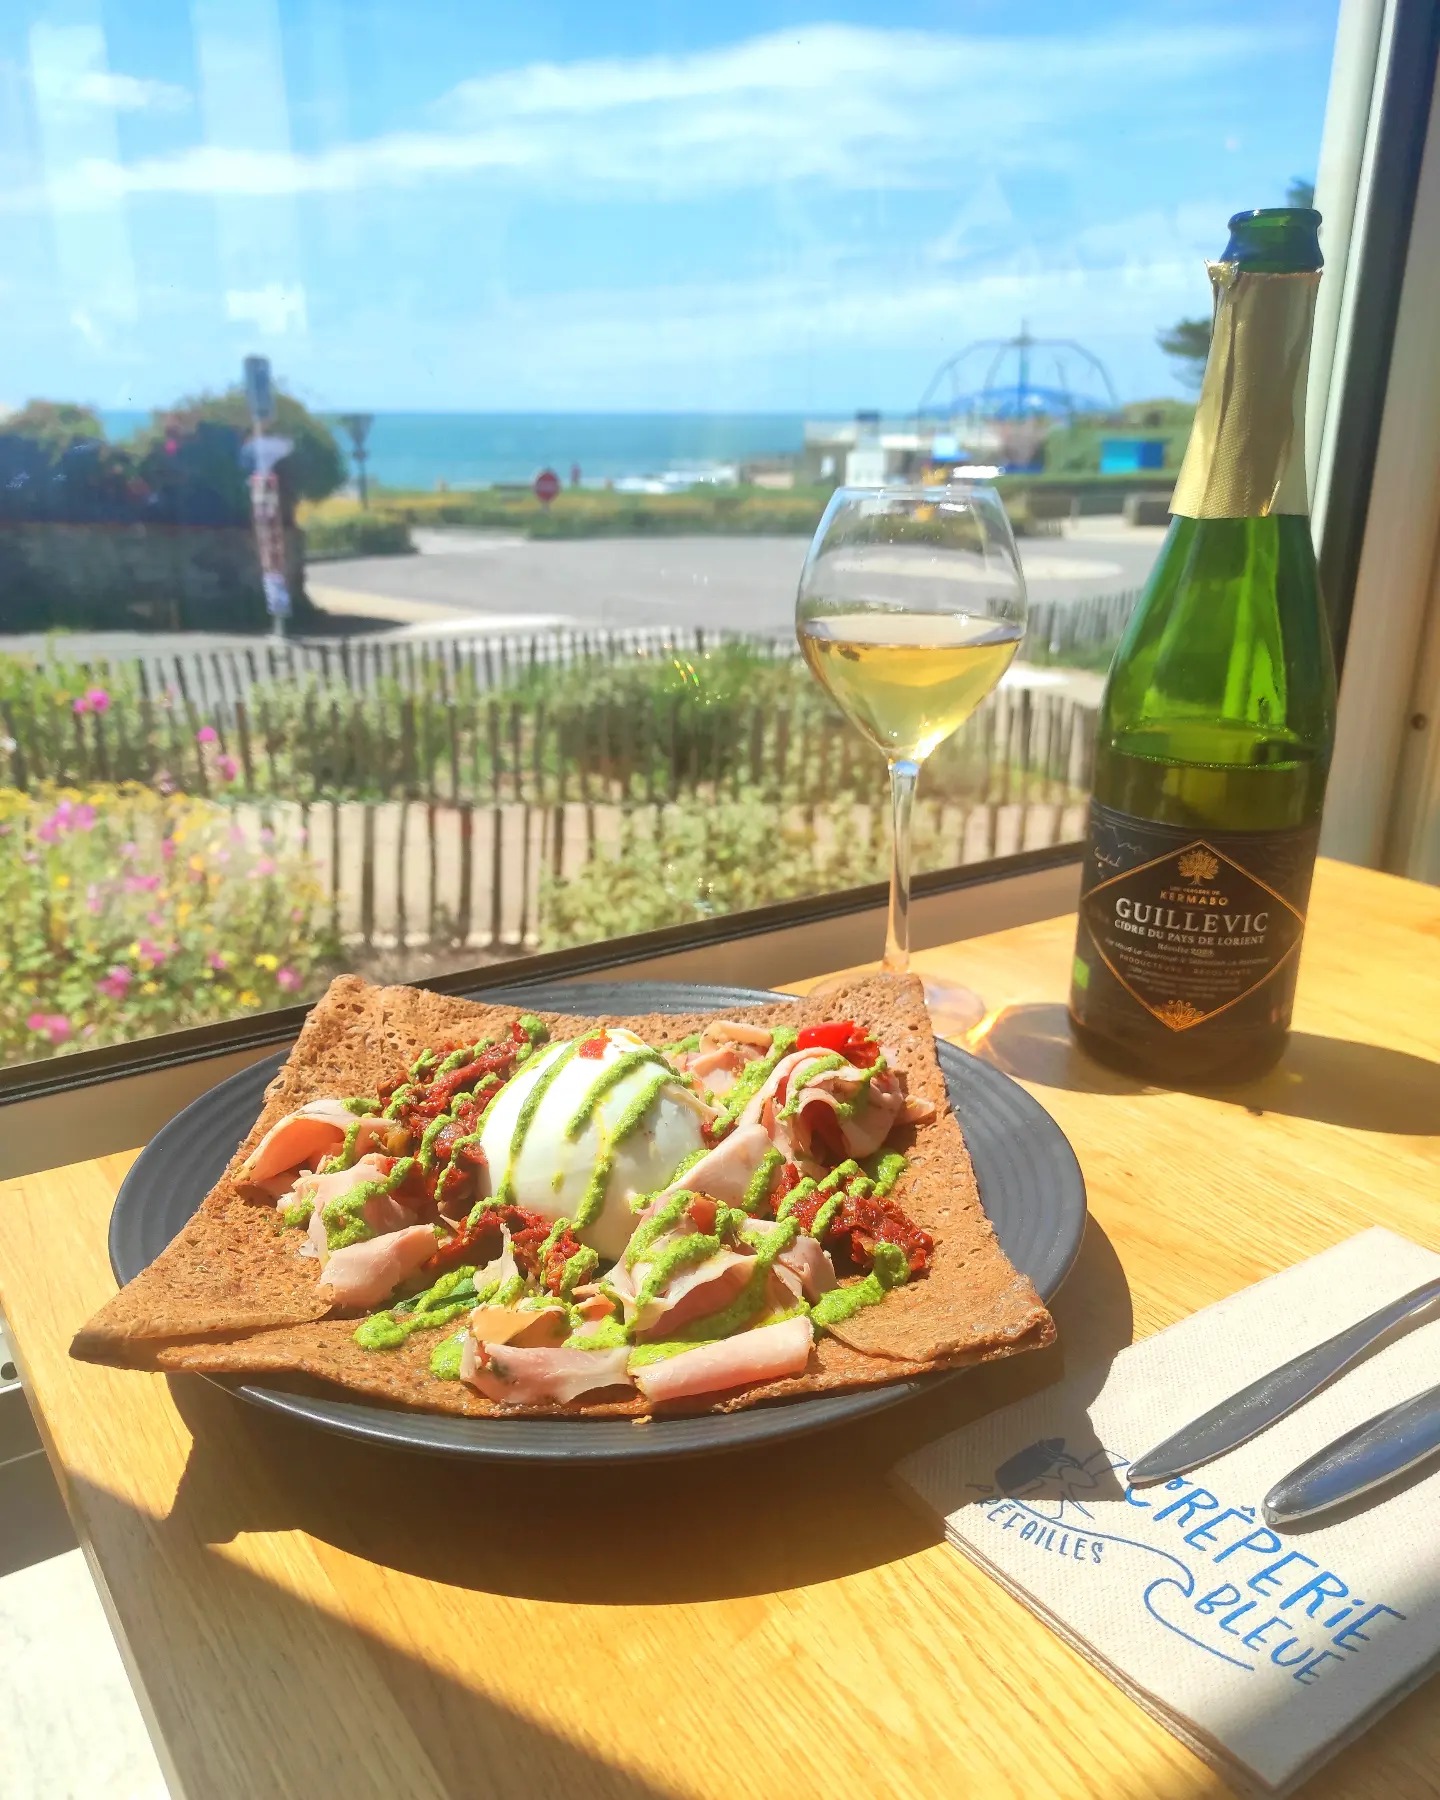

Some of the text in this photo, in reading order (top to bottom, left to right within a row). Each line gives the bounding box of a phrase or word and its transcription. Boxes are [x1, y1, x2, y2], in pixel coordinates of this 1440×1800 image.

[1159, 890, 1229, 907] KERMABO
[1115, 897, 1269, 933] GUILLEVIC
[1114, 919, 1265, 946] CIDRE DU PAYS DE LORIENT
[1193, 1582, 1345, 1686] BLEUE
